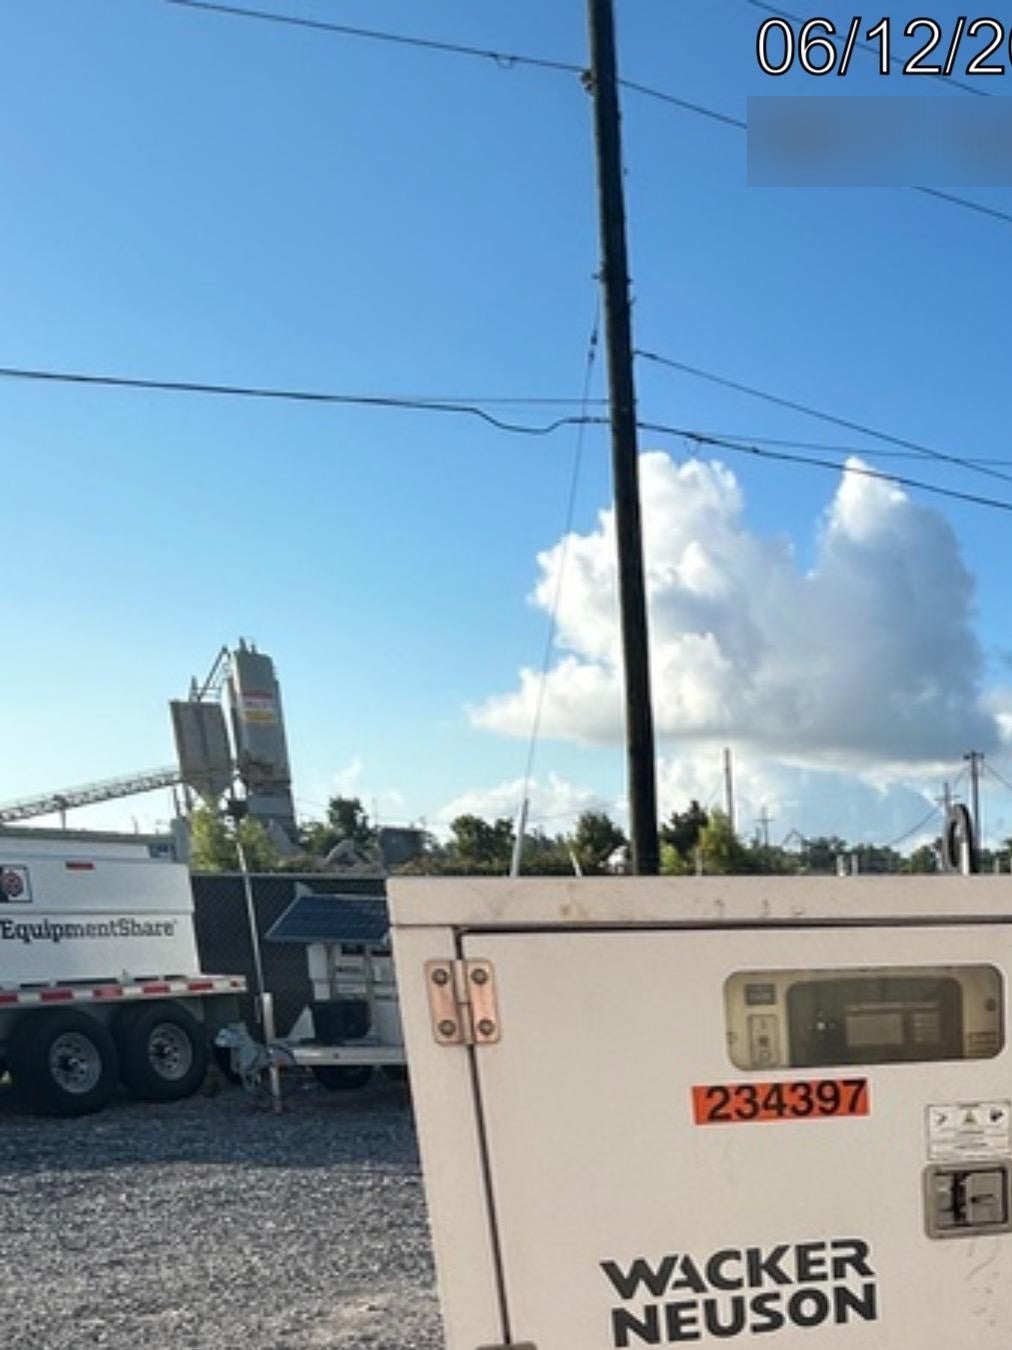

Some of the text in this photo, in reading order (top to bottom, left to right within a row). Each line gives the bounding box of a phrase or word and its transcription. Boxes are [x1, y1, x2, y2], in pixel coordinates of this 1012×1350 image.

[0, 918, 176, 943] EquipmentShare
[707, 1079, 867, 1122] 234397
[600, 1238, 877, 1300] WACKER
[611, 1283, 878, 1348] NEUSON
